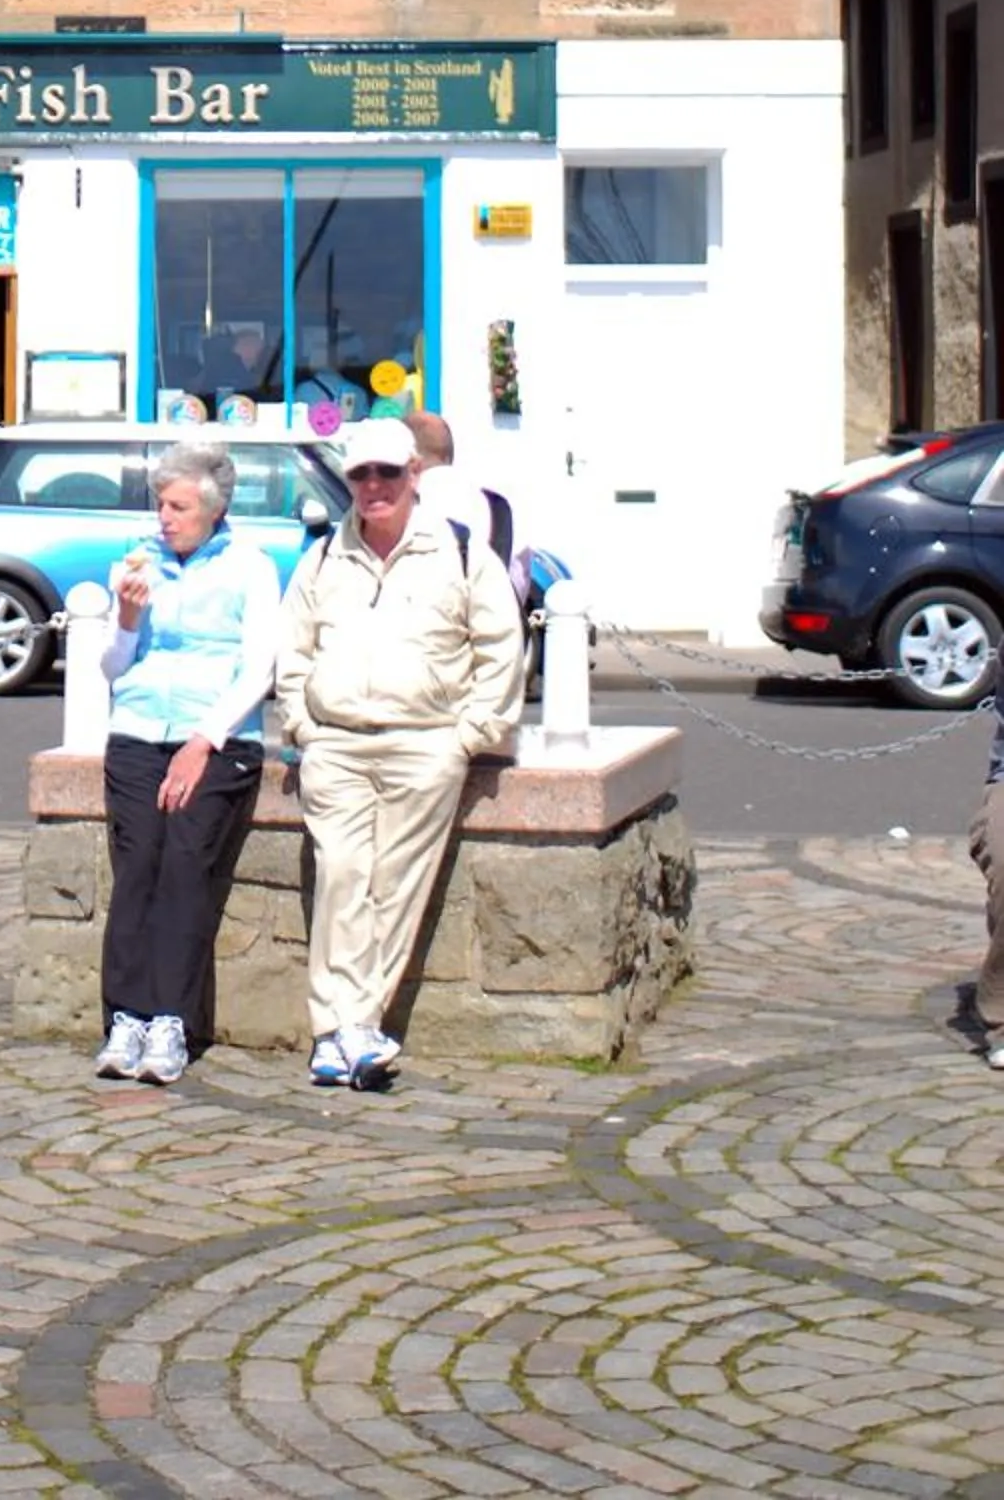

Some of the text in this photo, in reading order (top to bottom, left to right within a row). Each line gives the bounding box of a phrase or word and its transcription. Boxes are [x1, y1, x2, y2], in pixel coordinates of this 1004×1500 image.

[308, 60, 482, 76] Voted Best in Scotland
[149, 65, 270, 124] Bar
